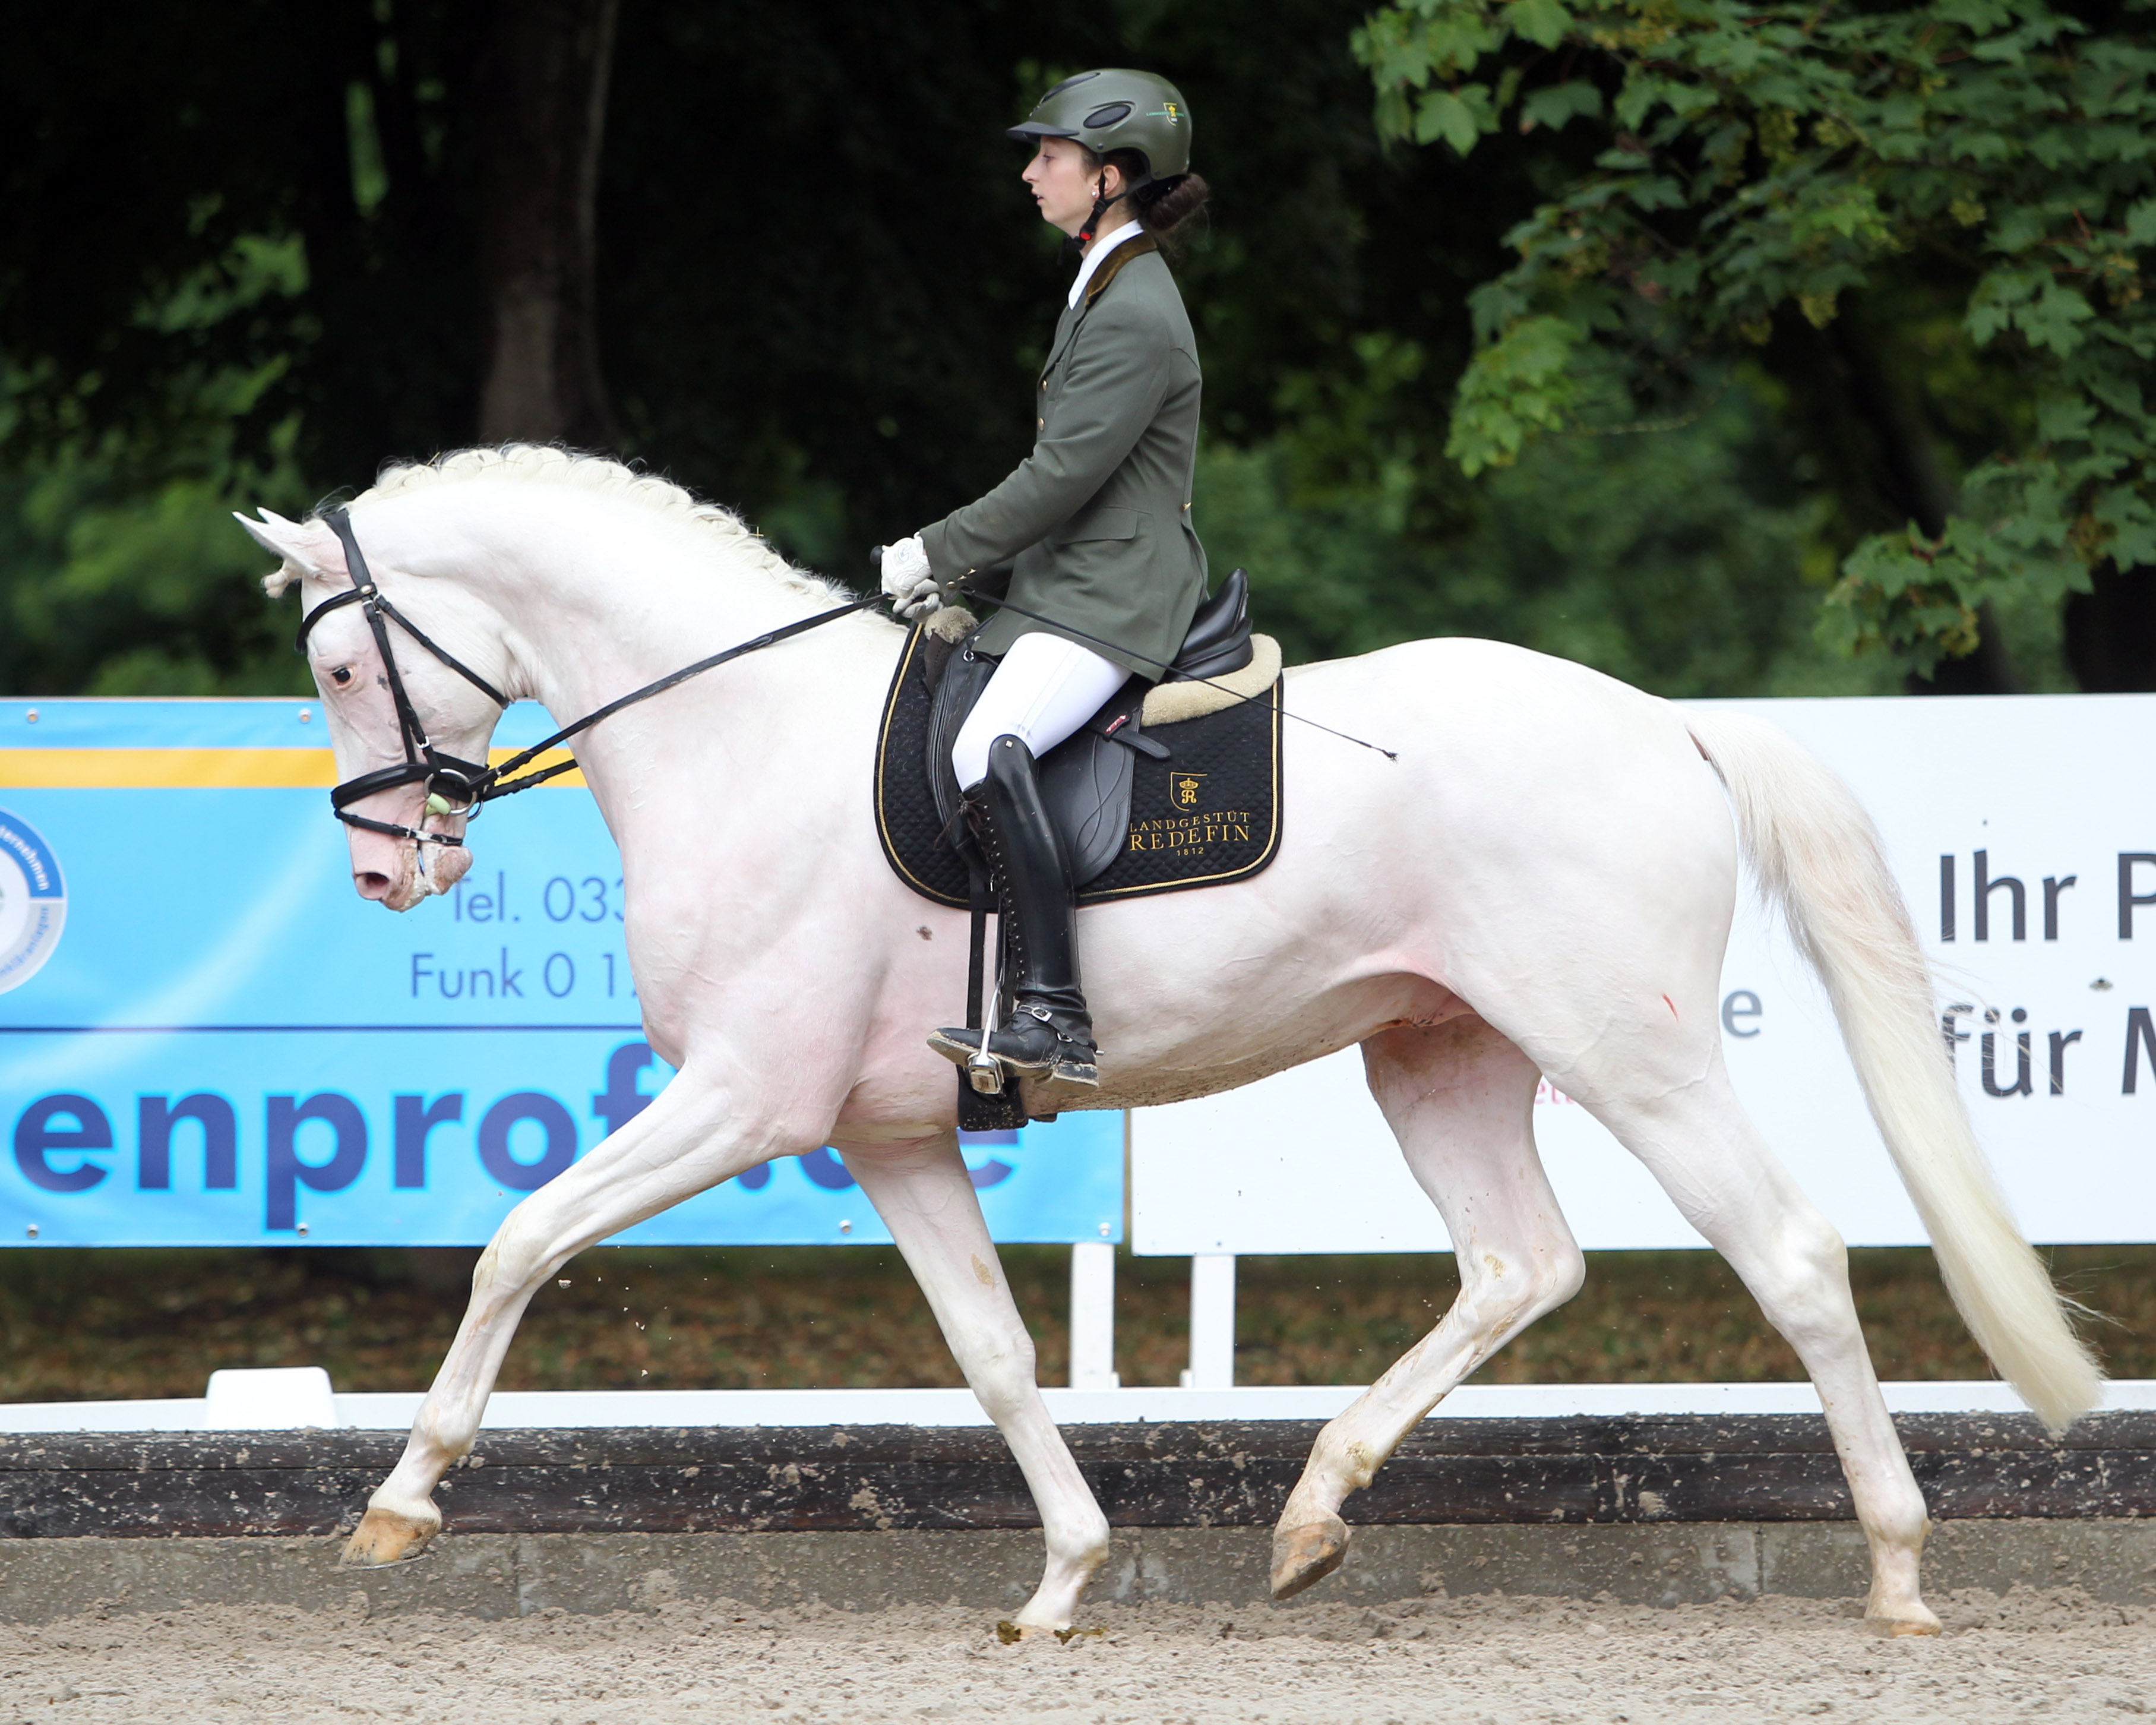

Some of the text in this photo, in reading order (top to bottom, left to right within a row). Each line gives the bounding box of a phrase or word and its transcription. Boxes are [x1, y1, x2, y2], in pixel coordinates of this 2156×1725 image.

[1130, 810, 1250, 832] LANDGESTÜT
[1130, 824, 1250, 851] REDEFIN
[1176, 847, 1205, 857] 1812
[454, 870, 520, 922] Tel.
[1940, 843, 2077, 942] Ihr
[412, 947, 524, 999] Funk
[543, 952, 575, 999] 0
[1942, 1002, 2083, 1098] für
